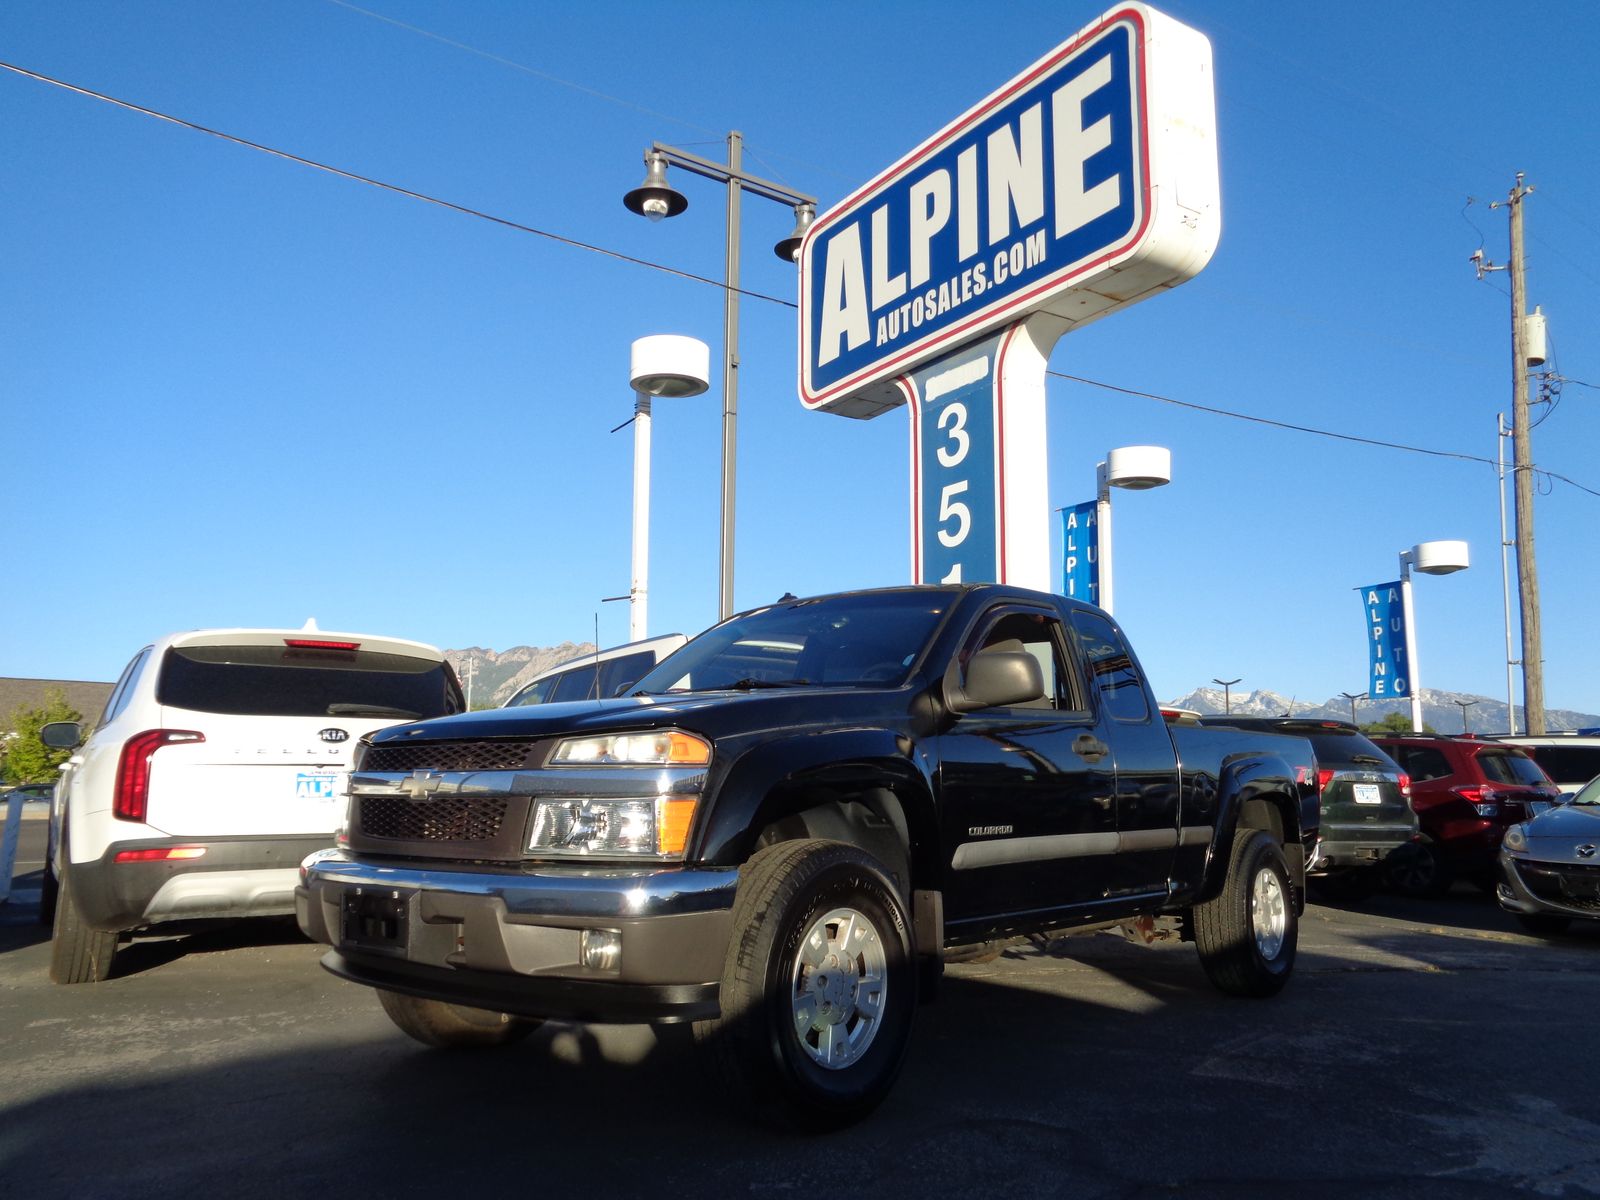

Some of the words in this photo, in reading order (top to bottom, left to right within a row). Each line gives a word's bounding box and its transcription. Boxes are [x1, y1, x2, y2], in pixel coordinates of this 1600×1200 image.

[818, 53, 1120, 368] ALPINE
[876, 228, 1046, 347] AUTOSALES.COM
[1367, 590, 1386, 694] ALPINE
[1388, 587, 1406, 693] AUTO
[322, 729, 346, 741] KIA
[968, 825, 1013, 836] COLORADO
